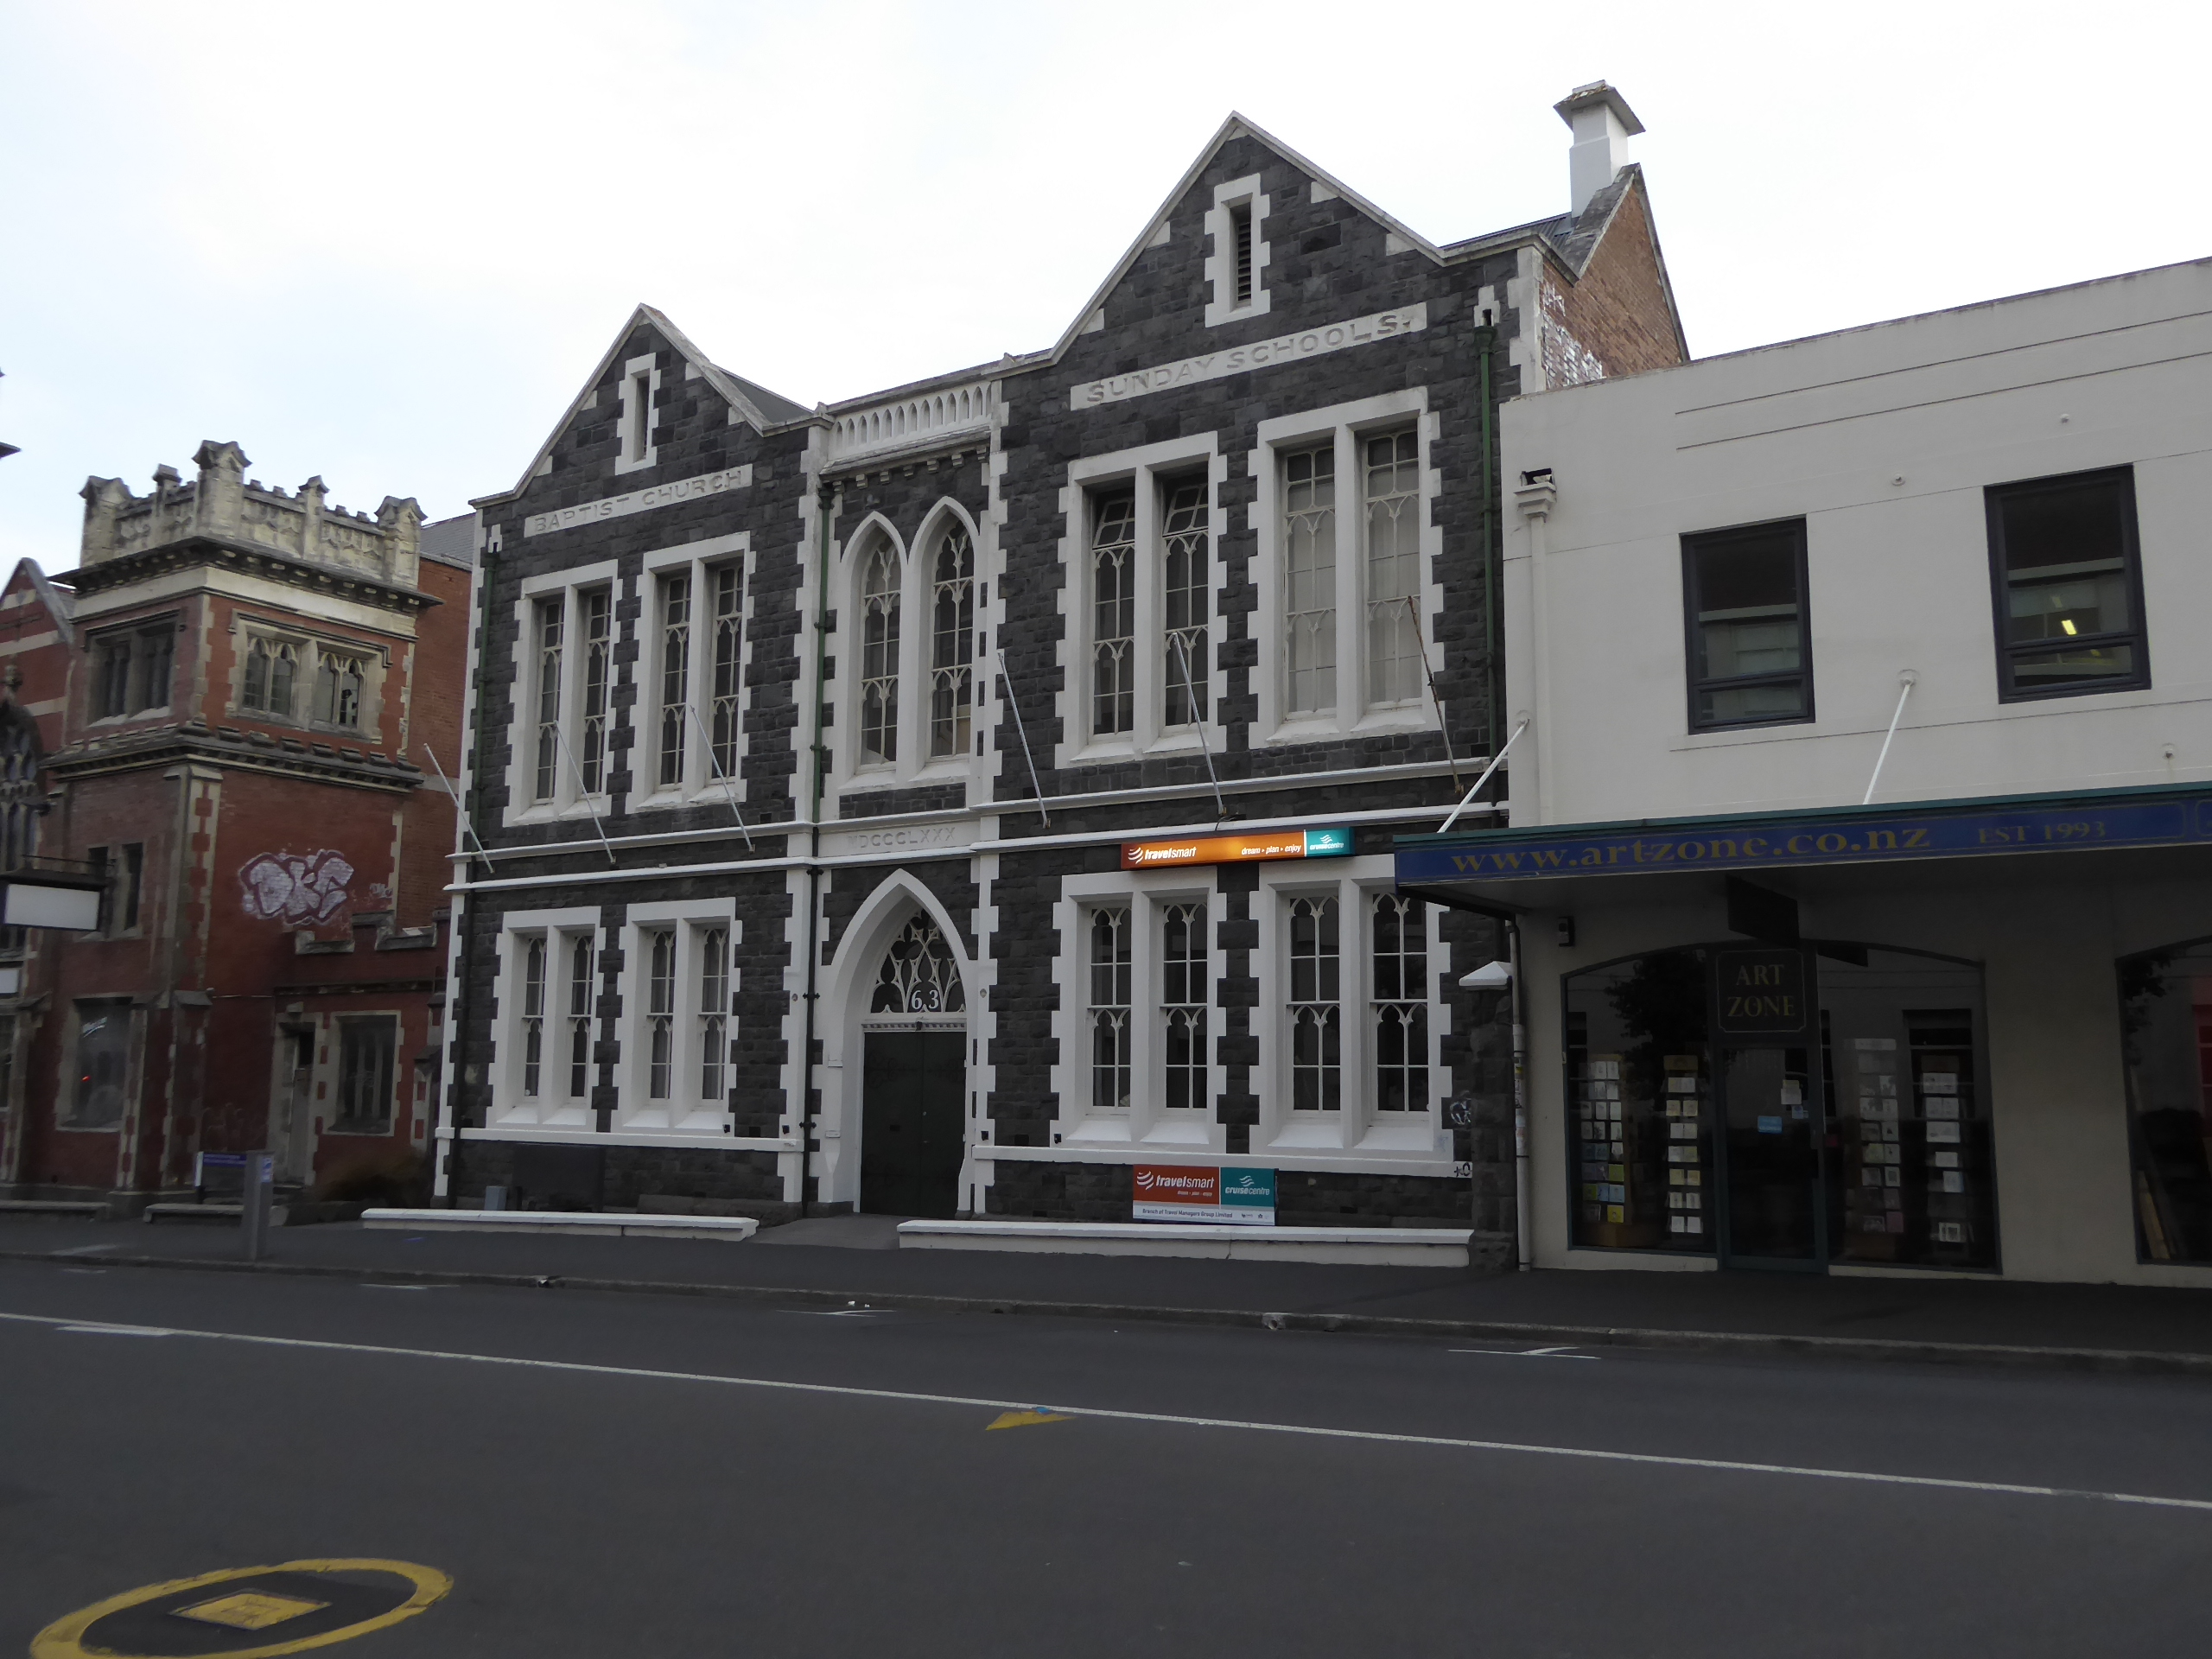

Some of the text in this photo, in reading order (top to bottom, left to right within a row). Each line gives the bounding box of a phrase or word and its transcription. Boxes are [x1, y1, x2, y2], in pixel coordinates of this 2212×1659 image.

[1086, 356, 1215, 403] SUNDAY
[534, 470, 741, 532] BAPTIST CHURCH
[1978, 820, 2106, 844] EST 1993
[1145, 846, 1197, 860] travelsmart
[1241, 844, 1302, 855] dream plan enjoy
[1736, 963, 1785, 986] ART
[911, 989, 939, 1009] 63
[1727, 995, 1796, 1018] ZONE
[1156, 1175, 1215, 1189] travelsmart
[1225, 1186, 1270, 1196] cruisecentre
